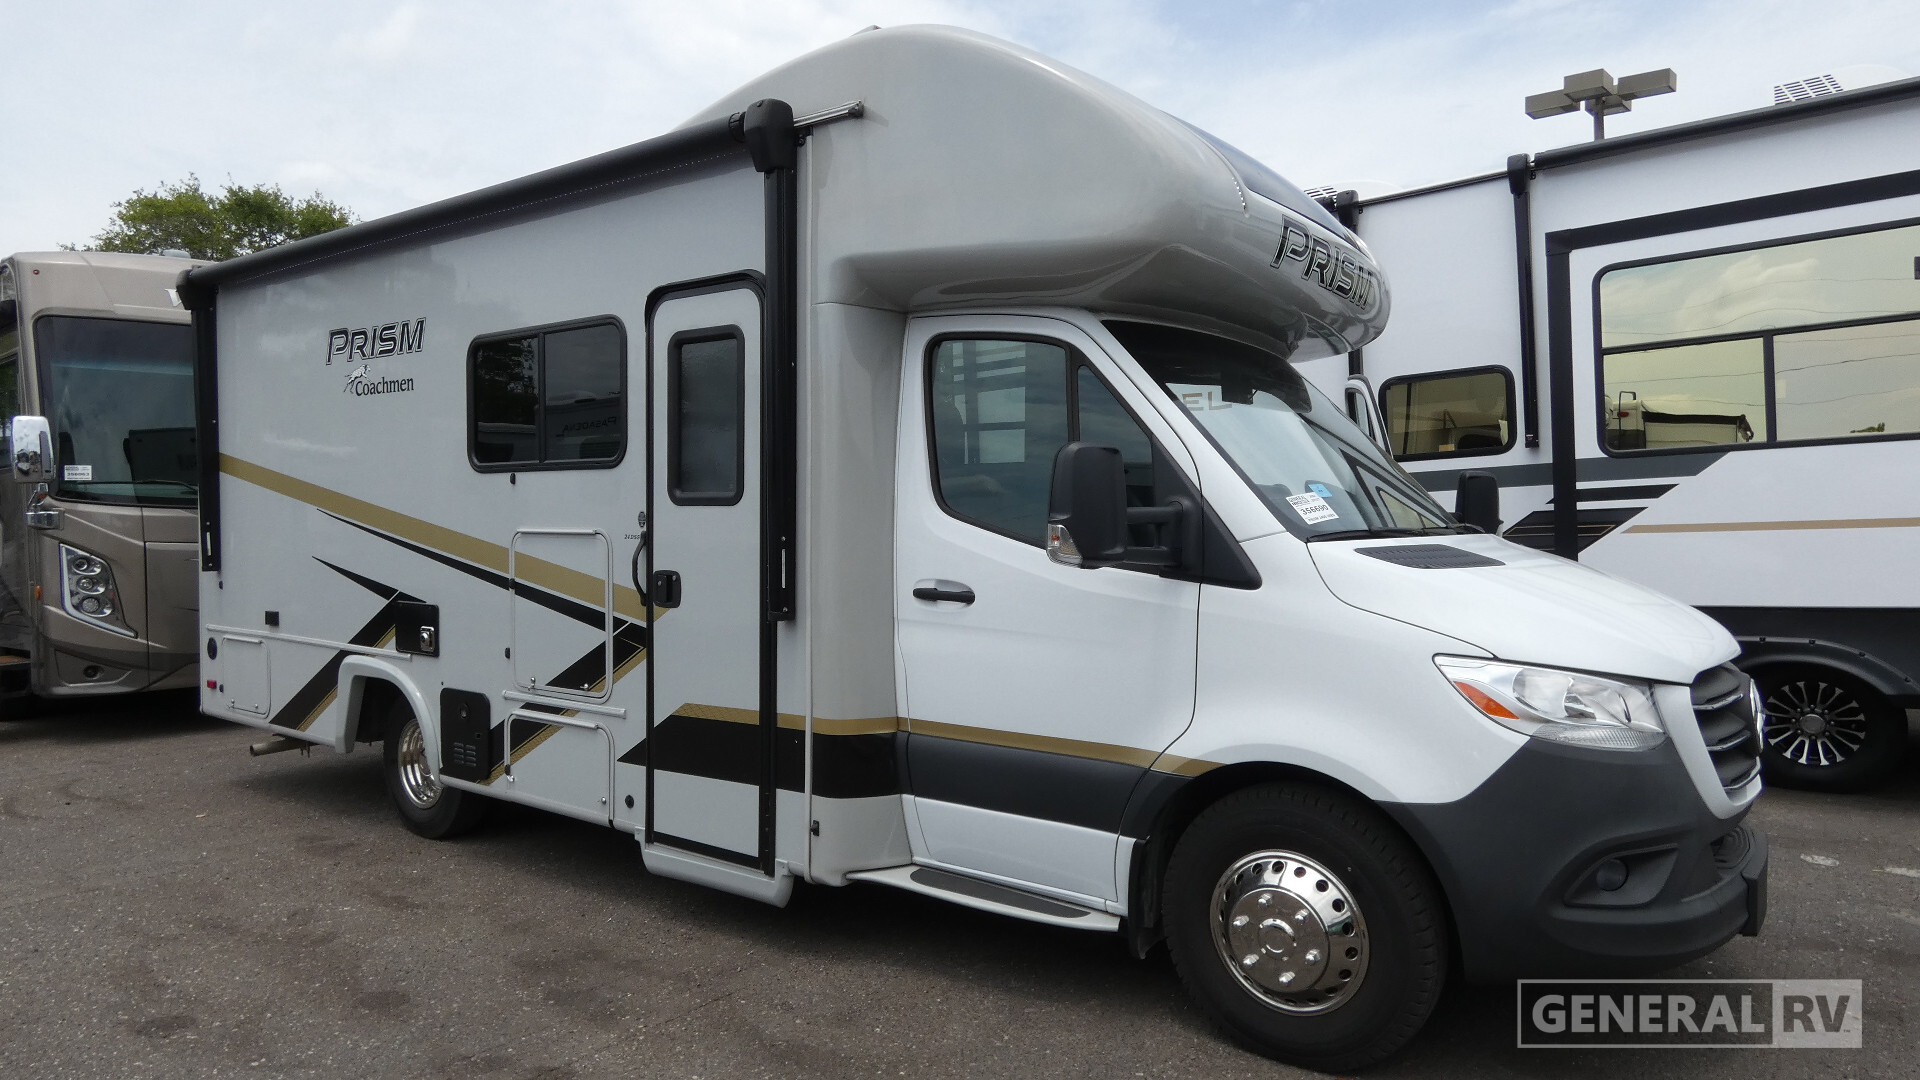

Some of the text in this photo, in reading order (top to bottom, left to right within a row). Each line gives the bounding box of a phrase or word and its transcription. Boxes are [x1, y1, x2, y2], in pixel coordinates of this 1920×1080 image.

[1270, 214, 1372, 310] PRISM
[326, 317, 426, 365] PRISM
[355, 377, 414, 396] Coachmen
